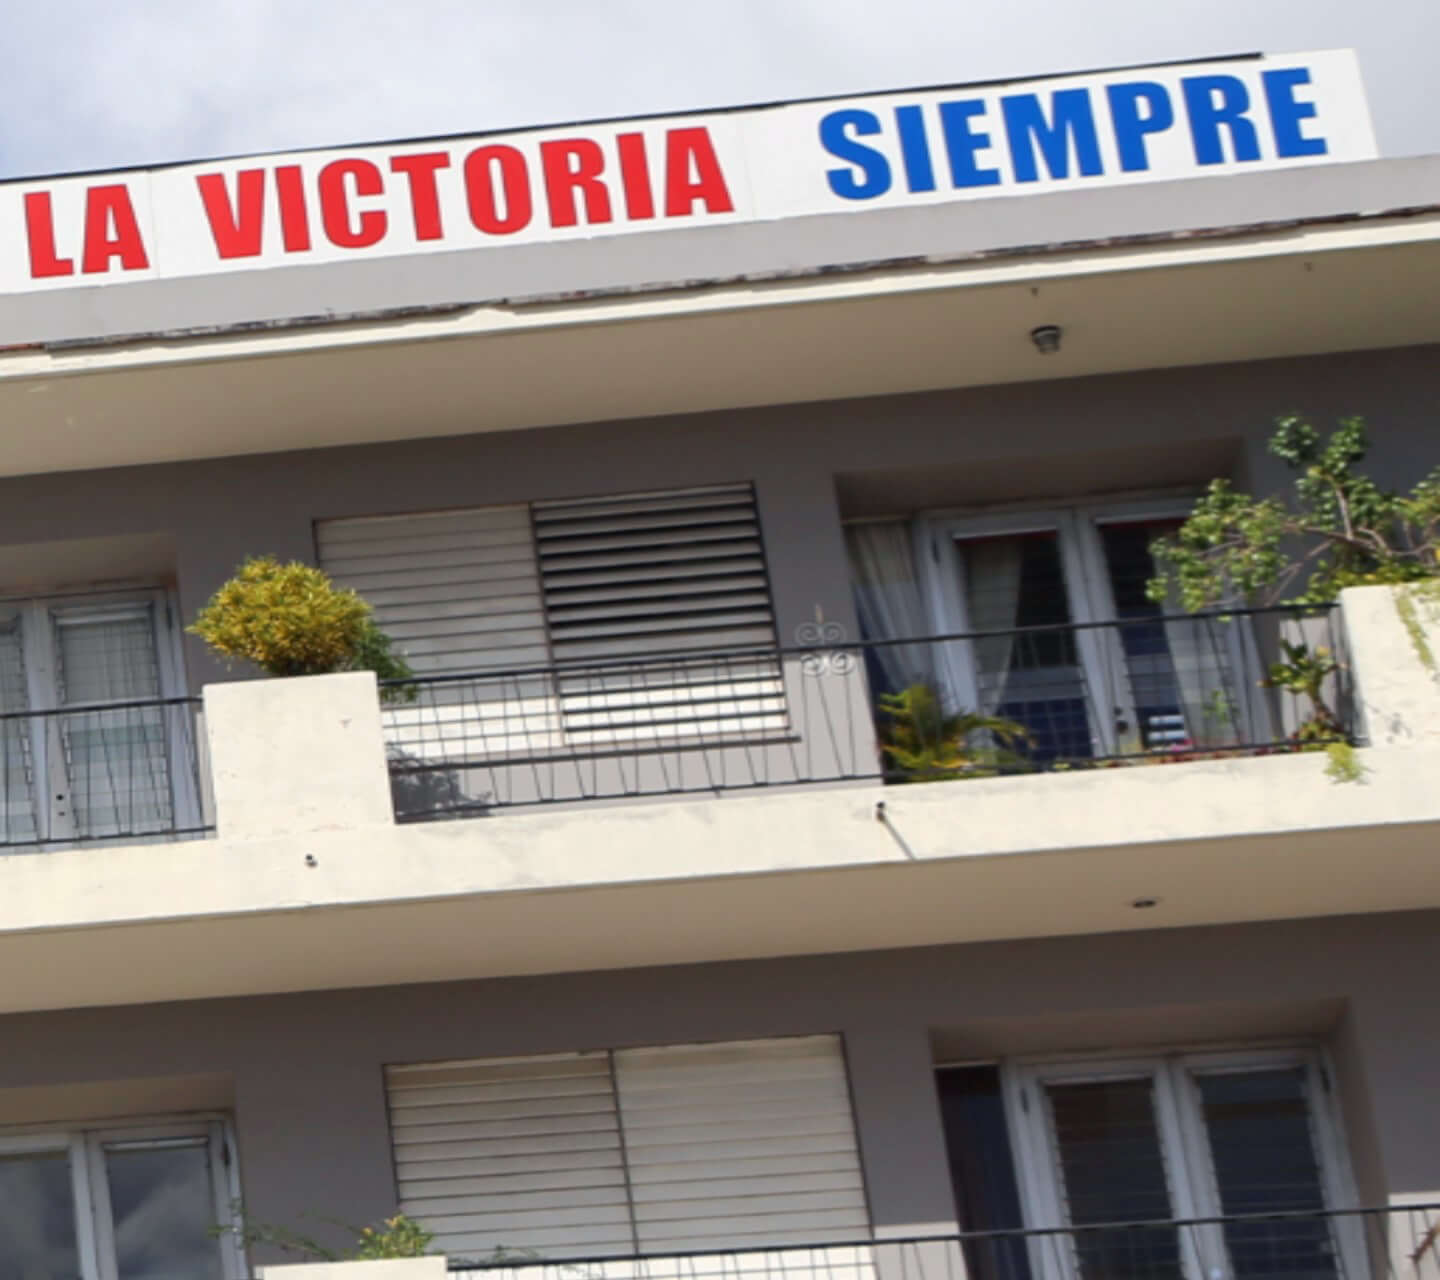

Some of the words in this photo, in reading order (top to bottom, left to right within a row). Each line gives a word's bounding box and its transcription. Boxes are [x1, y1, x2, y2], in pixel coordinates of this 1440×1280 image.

[22, 183, 151, 279] LA
[195, 125, 735, 260] VICTORIA
[818, 66, 1328, 200] SIEMPRE
